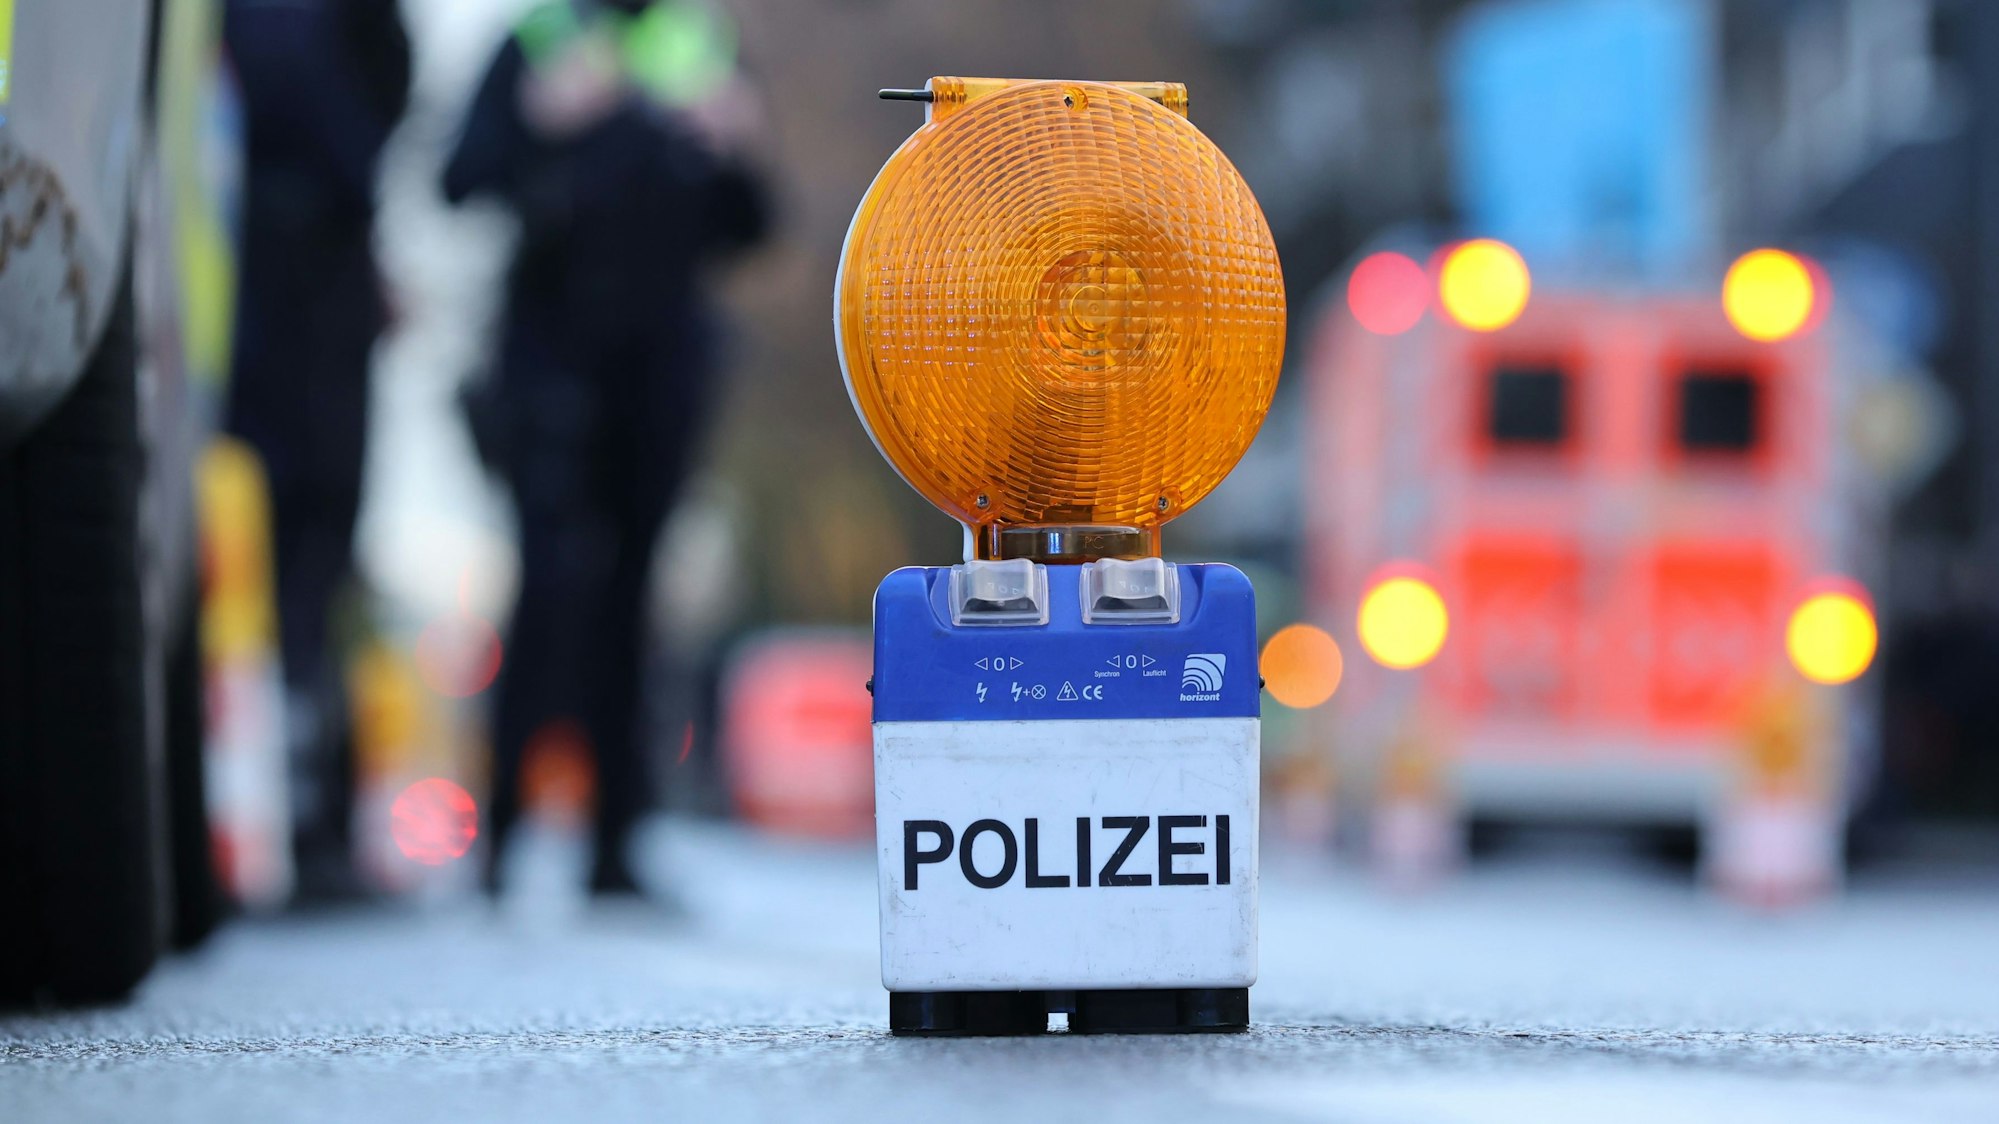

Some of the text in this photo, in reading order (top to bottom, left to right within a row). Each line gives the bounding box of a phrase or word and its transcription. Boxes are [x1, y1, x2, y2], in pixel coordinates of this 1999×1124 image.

[1094, 670, 1120, 678] Synchron
[1143, 669, 1167, 677] Lauflicht
[1082, 685, 1103, 700] CE
[1179, 692, 1221, 702] horizont
[903, 814, 1231, 890] POLIZEI
